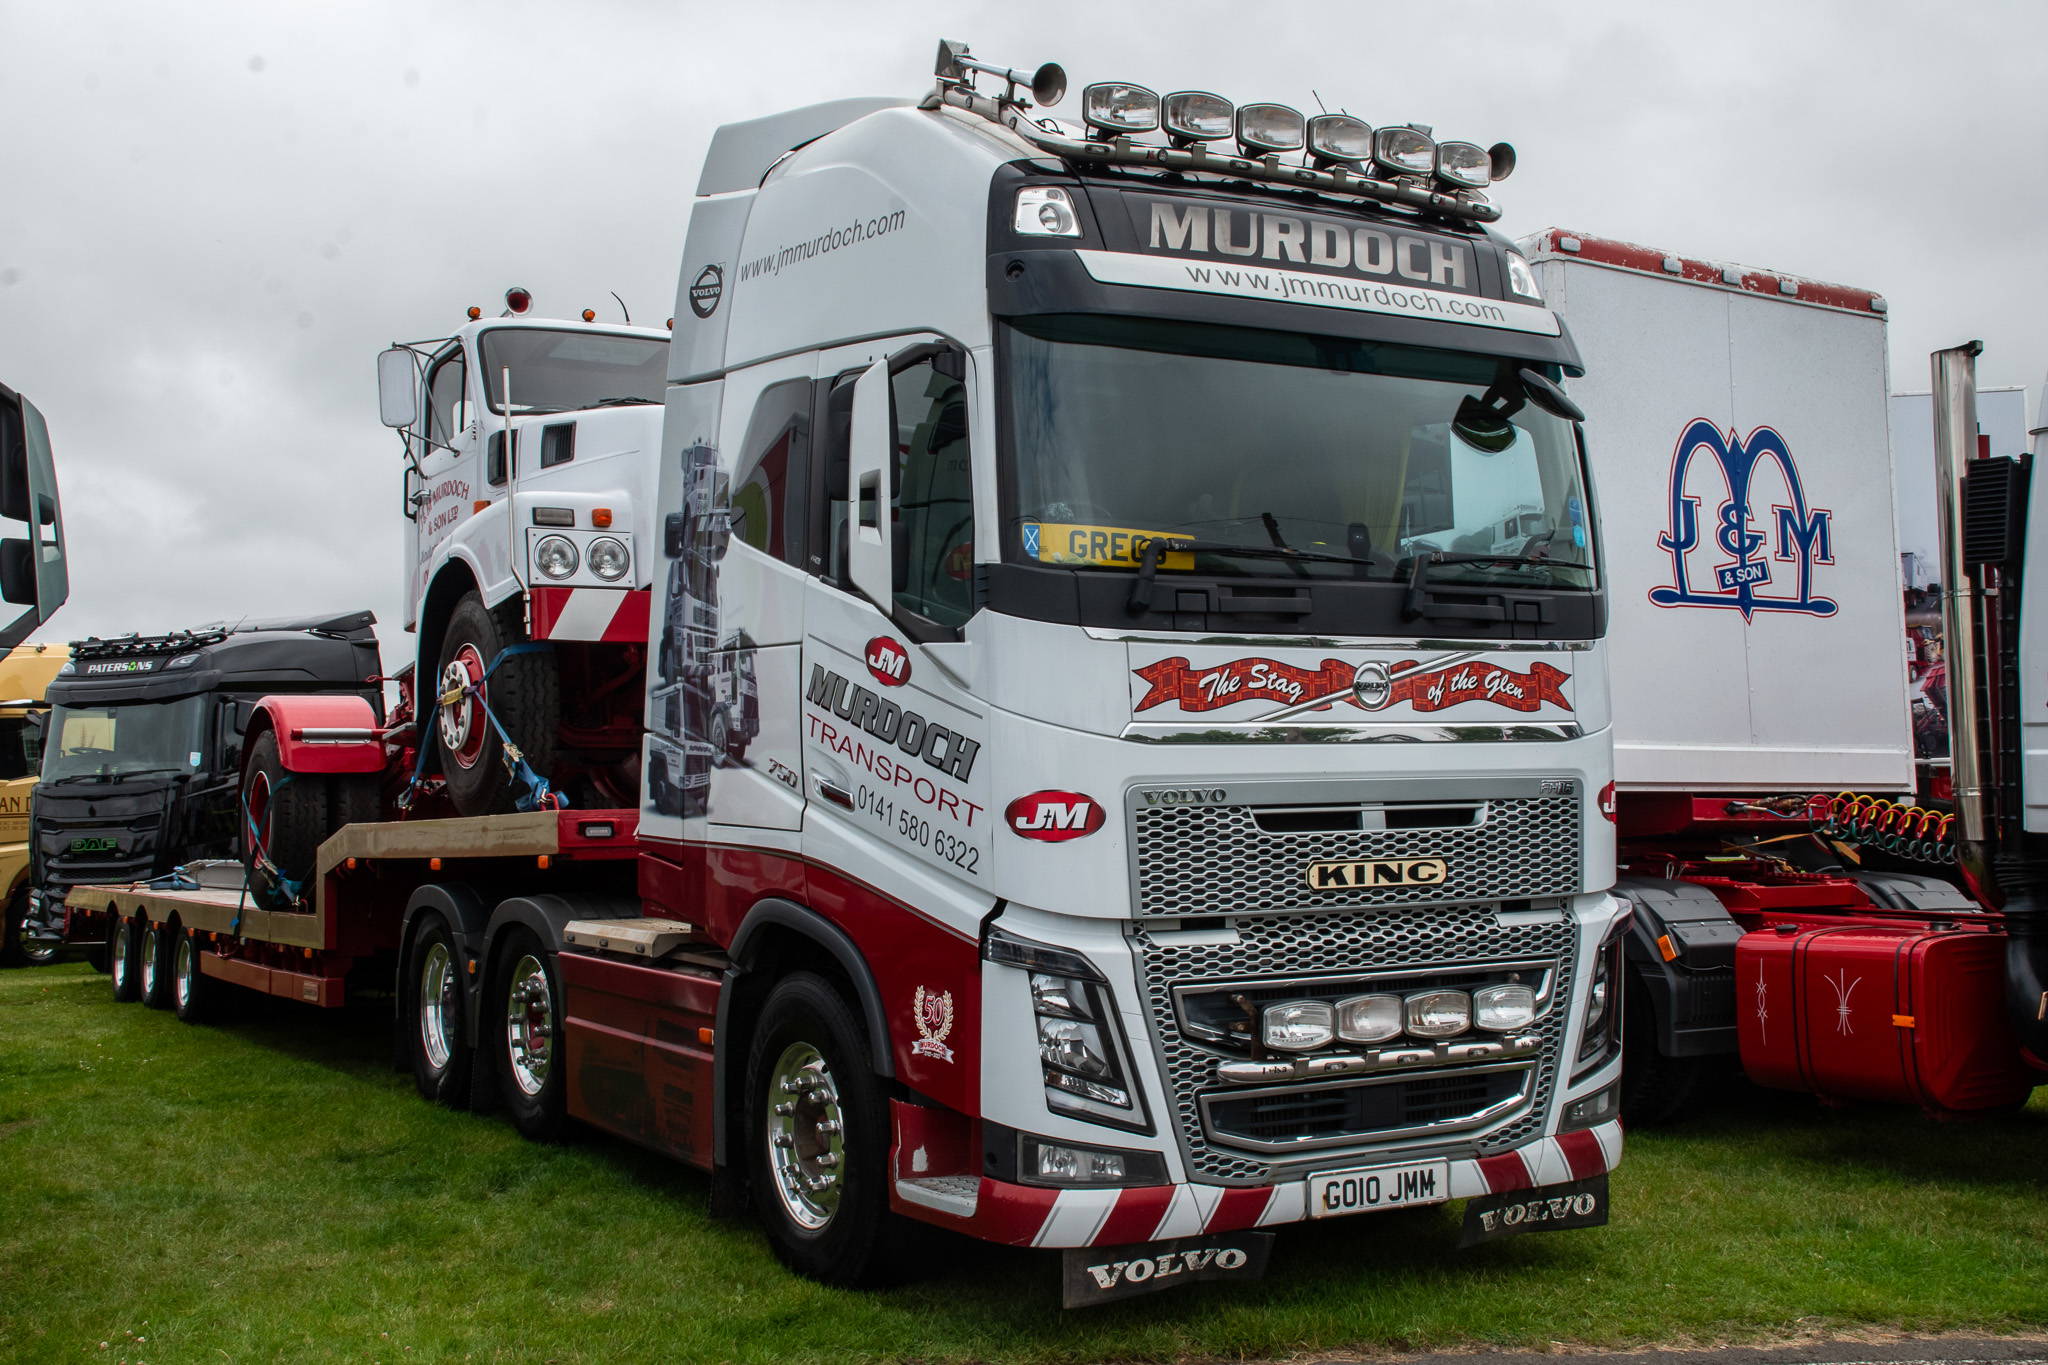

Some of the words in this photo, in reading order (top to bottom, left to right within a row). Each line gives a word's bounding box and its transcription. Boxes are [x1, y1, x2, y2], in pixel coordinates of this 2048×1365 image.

[740, 209, 906, 282] www.jmmurdoch.com
[1149, 202, 1467, 289] MURDOCH
[691, 286, 721, 298] VOLVO
[1185, 265, 1506, 322] www.jmmurdoch.com
[1725, 572, 1734, 584] &
[1736, 565, 1762, 582] SON
[868, 646, 906, 680] JM
[1199, 668, 1242, 703] The
[1248, 663, 1304, 704] Stag
[1427, 674, 1445, 706] of
[1450, 667, 1479, 693] the
[1484, 670, 1524, 701] Glen
[806, 663, 982, 785] MURDOCH
[807, 713, 985, 828] TRANSPORT
[1541, 782, 1575, 795] FH16
[1142, 788, 1227, 805] VOLVO
[858, 784, 893, 827] 0141
[899, 810, 930, 847] 580
[934, 829, 980, 875] 6322
[1016, 803, 1091, 830] JM
[71, 838, 118, 851] DAF
[1317, 860, 1441, 887] KING
[923, 995, 944, 1026] 50
[1325, 1176, 1381, 1210] GO10
[1388, 1169, 1436, 1202] JMM
[1480, 1193, 1596, 1232] VOLVO
[1087, 1248, 1248, 1290] VOLVO
